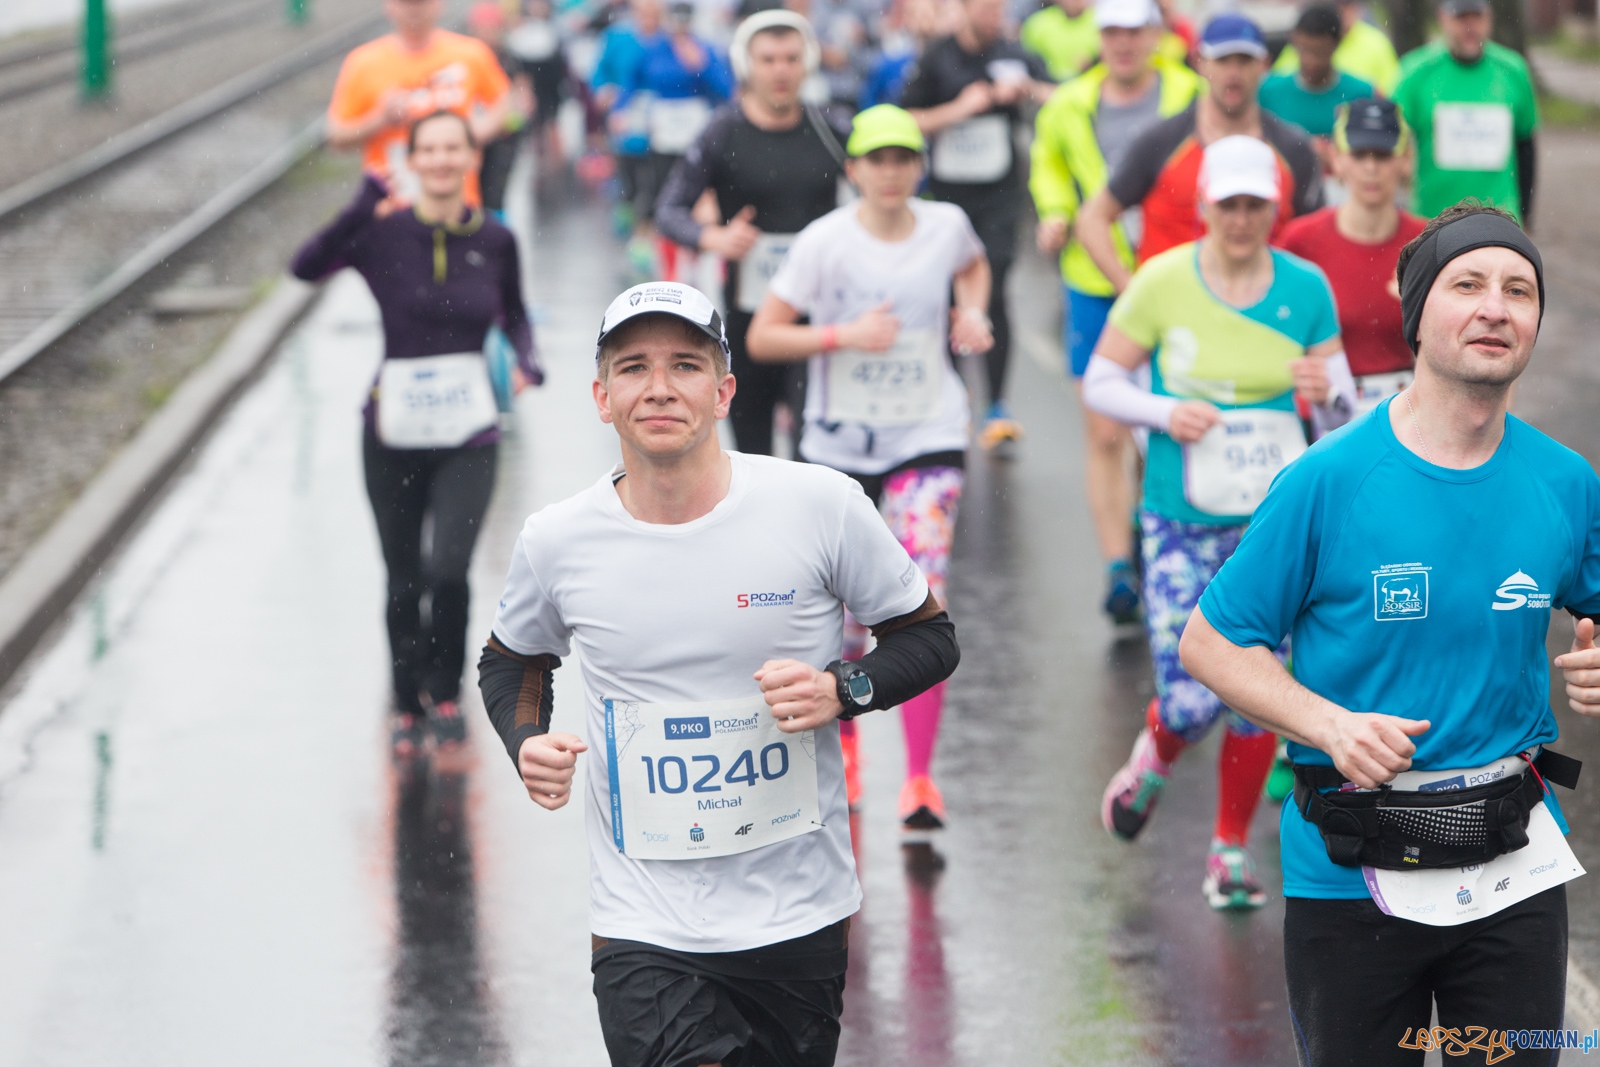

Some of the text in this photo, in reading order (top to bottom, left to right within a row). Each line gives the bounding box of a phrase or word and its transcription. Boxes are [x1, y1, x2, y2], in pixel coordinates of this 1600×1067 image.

[737, 593, 749, 608] 5
[681, 723, 704, 734] PKO
[641, 742, 789, 794] 10240
[697, 796, 743, 811] Michał
[734, 823, 754, 836] 4F
[1403, 856, 1419, 864] RUN
[1494, 877, 1510, 892] 4F
